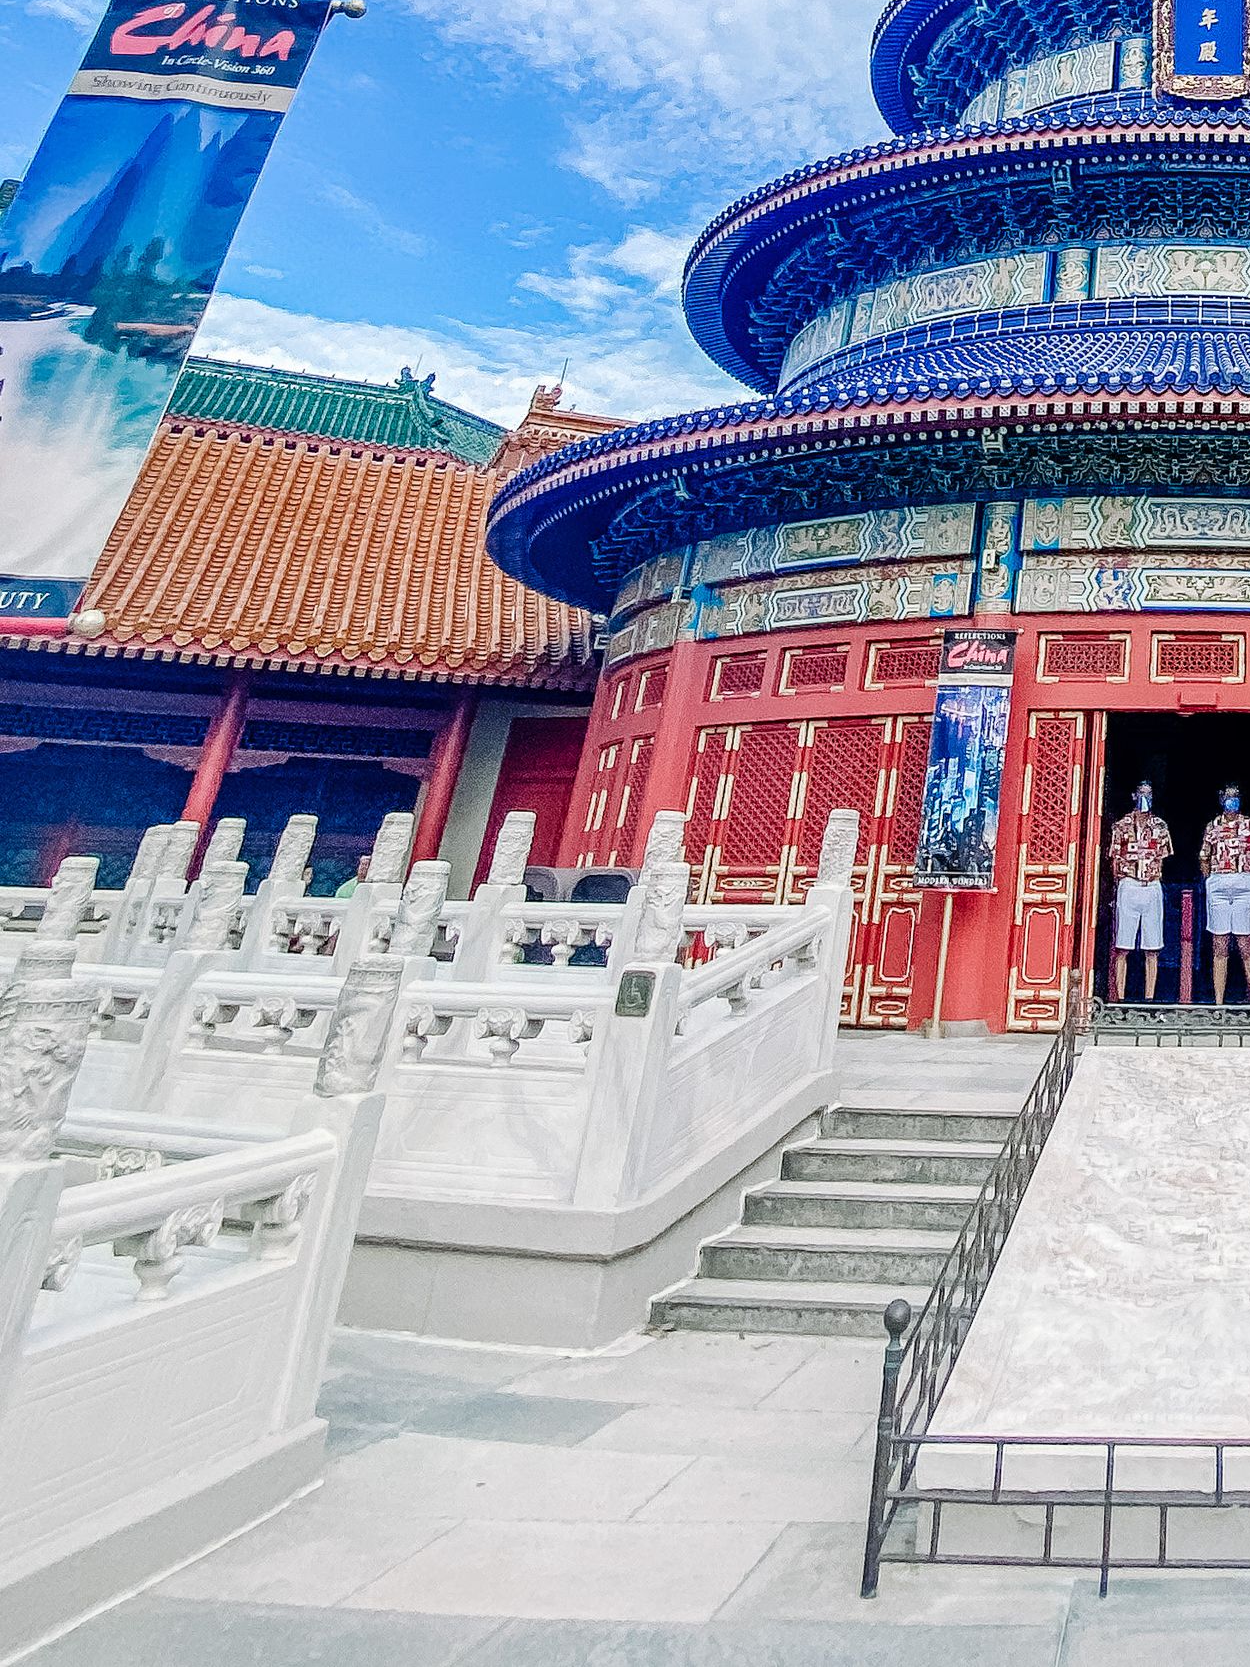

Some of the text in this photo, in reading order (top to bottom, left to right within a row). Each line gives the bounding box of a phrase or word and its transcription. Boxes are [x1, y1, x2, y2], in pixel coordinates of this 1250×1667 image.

[163, 4, 184, 18] of
[110, 3, 296, 61] China
[161, 55, 275, 75] In Circle-Vision 360
[93, 75, 272, 103] Showing Continuously
[948, 640, 1009, 668] China
